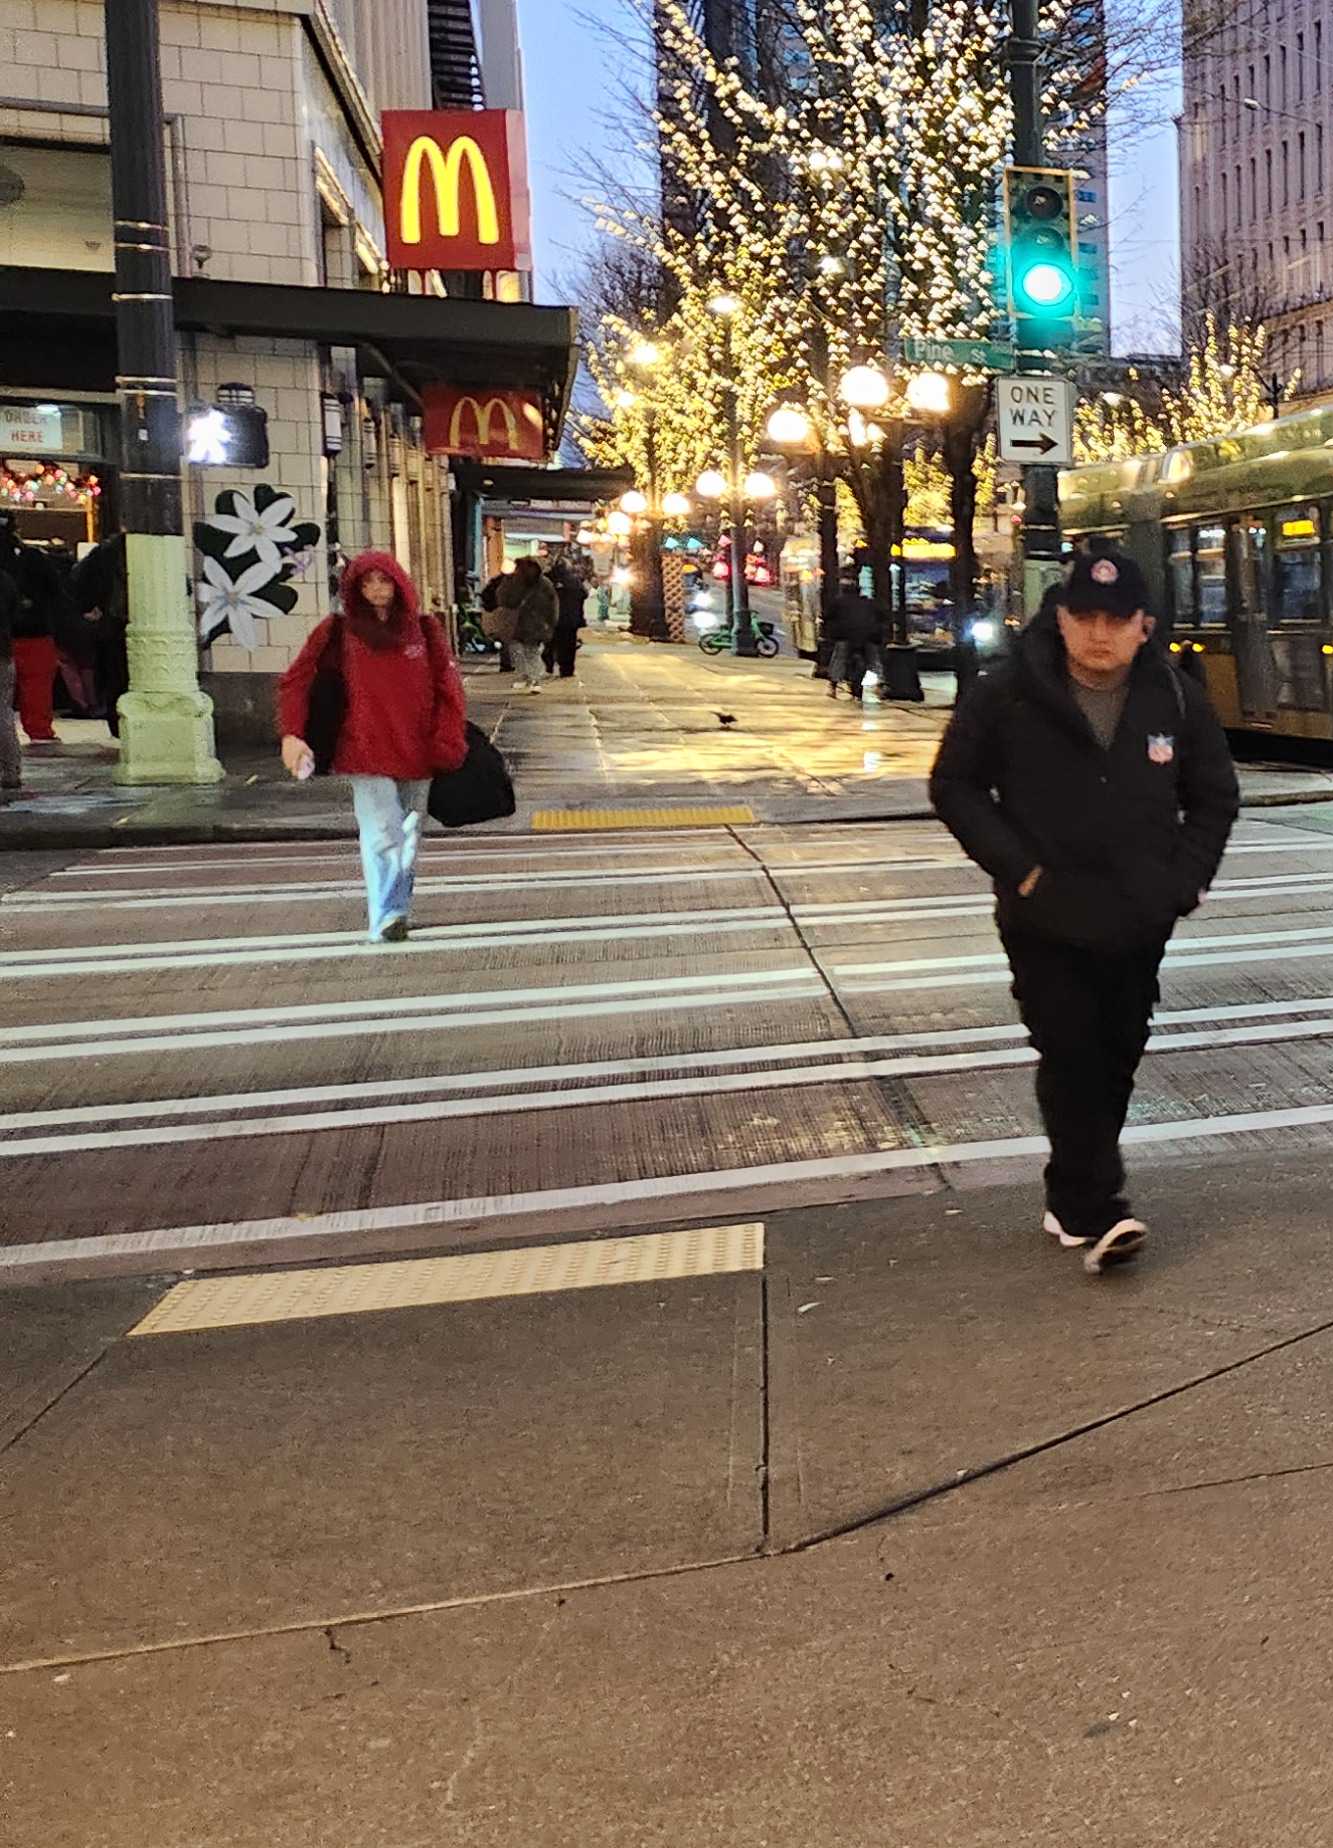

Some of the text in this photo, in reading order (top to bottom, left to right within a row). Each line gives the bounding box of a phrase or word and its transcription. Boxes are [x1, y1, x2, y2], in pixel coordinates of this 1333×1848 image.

[913, 340, 953, 360] Pine
[1010, 386, 1055, 404] ONE
[1009, 407, 1056, 426] WAY
